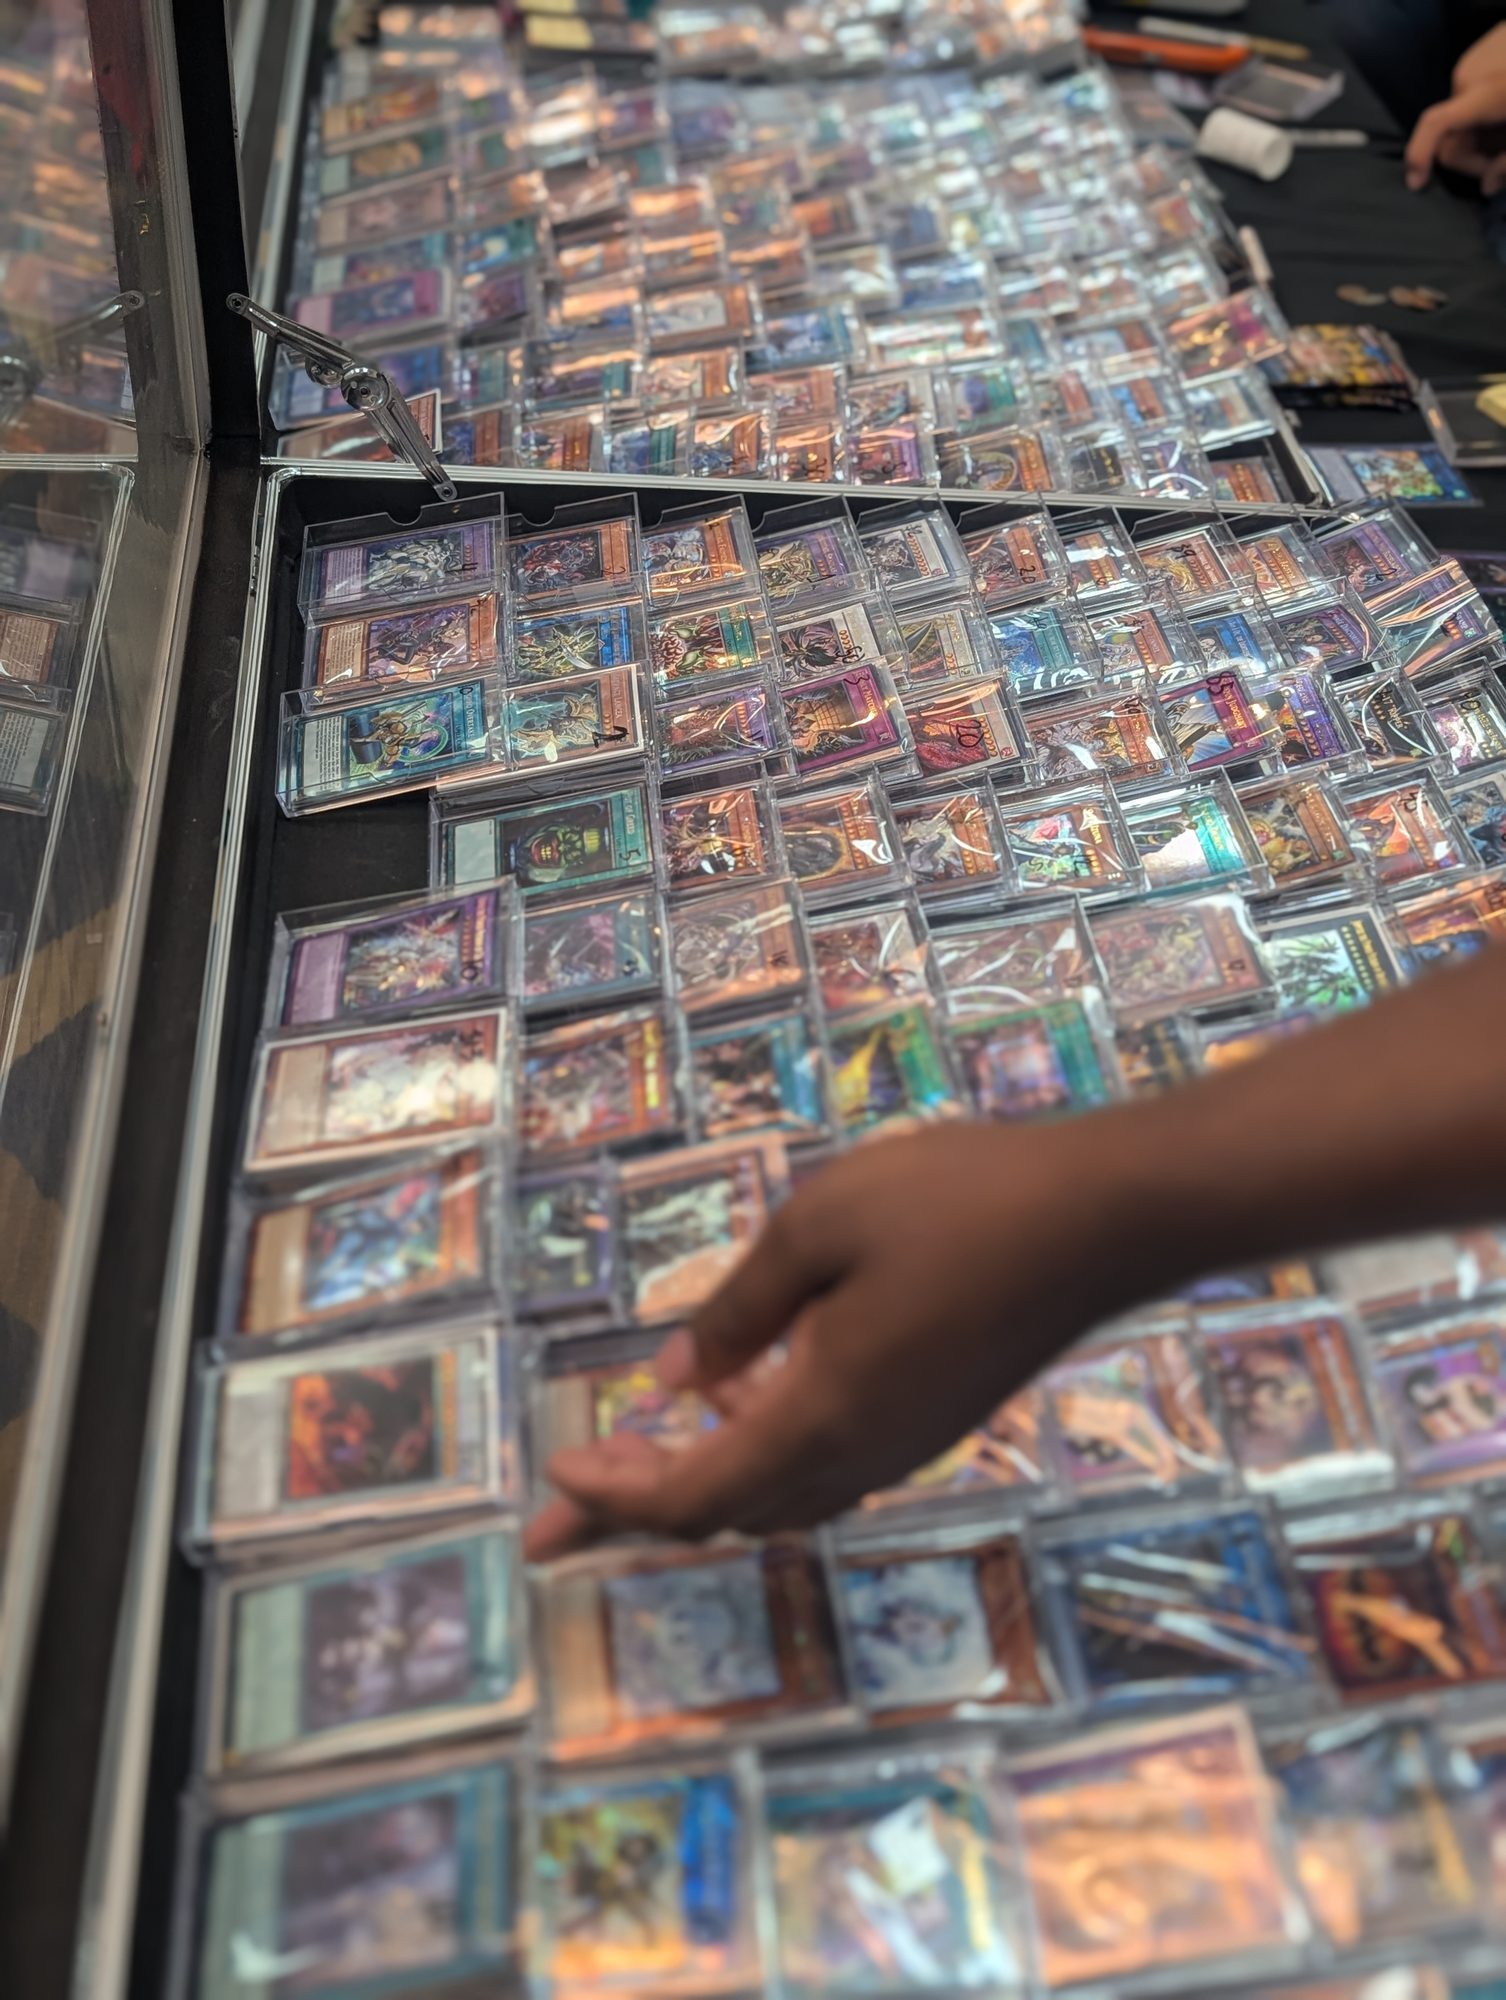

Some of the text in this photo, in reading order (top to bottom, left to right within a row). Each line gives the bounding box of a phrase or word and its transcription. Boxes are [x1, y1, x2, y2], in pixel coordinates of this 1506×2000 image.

[1019, 565, 1036, 584] 20
[955, 719, 986, 748] 20
[618, 848, 642, 861] 5
